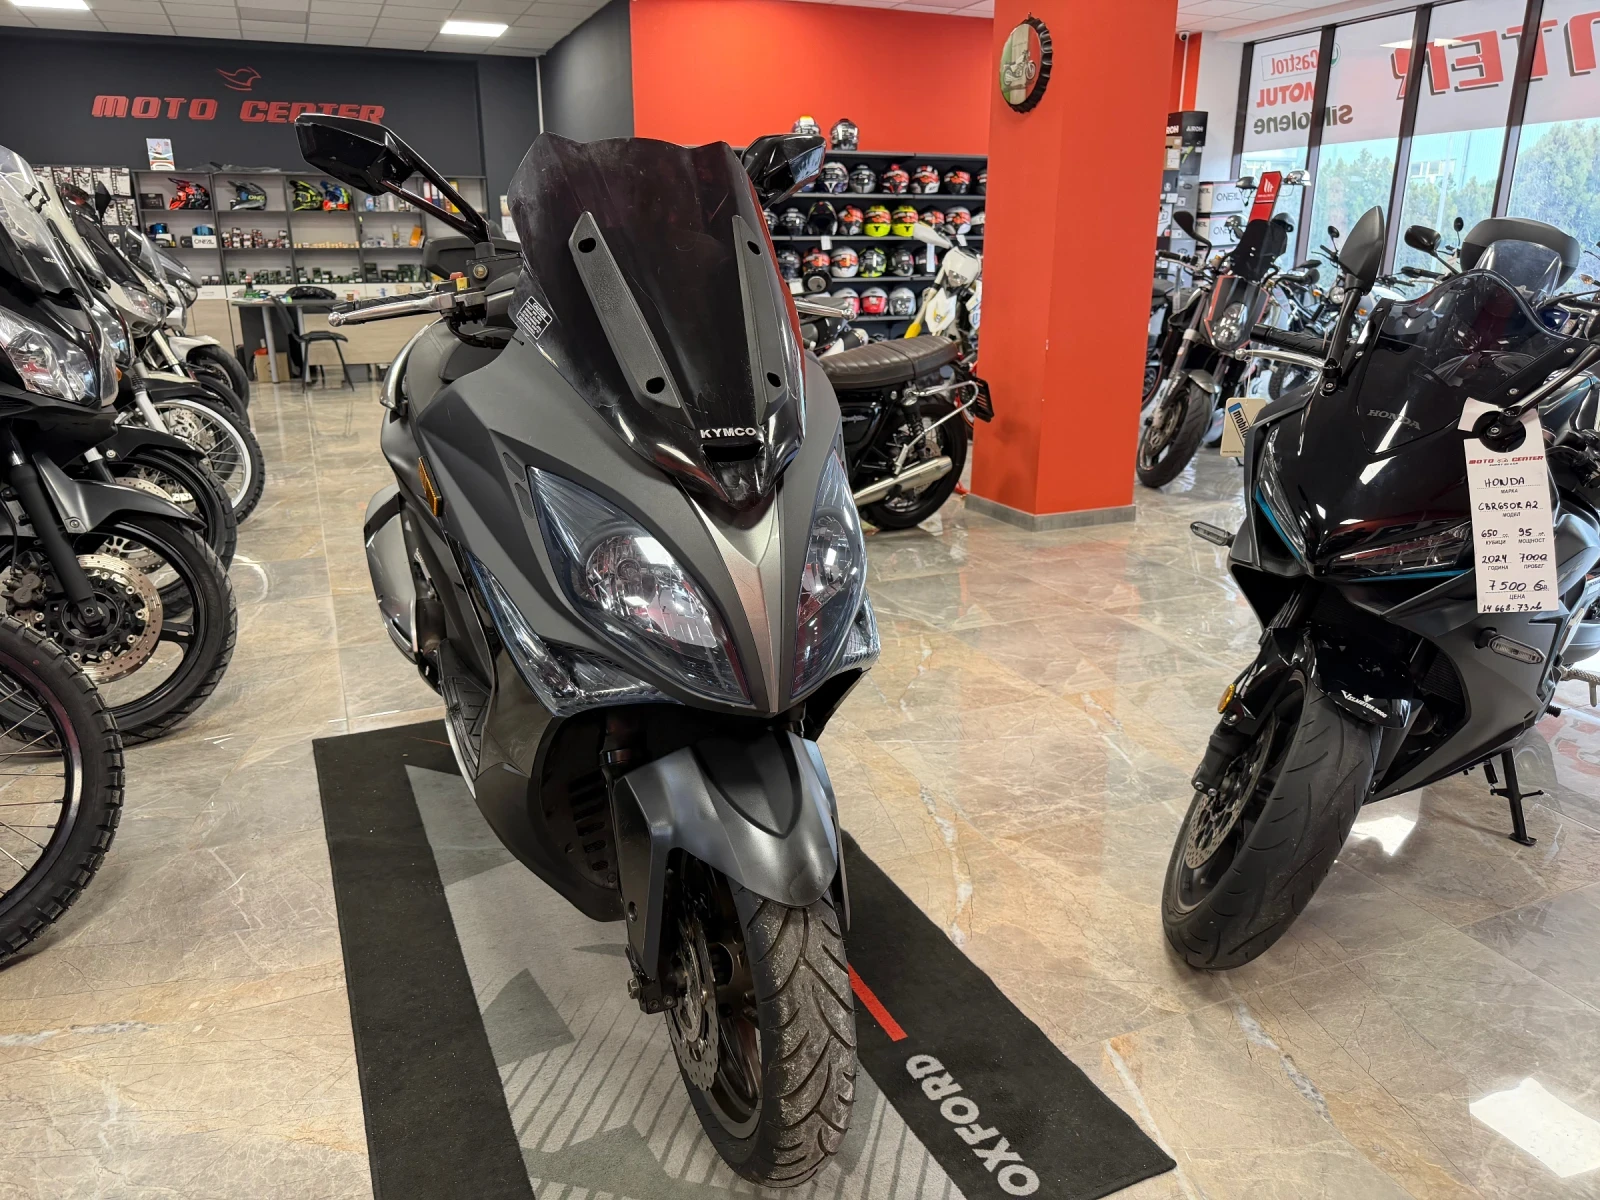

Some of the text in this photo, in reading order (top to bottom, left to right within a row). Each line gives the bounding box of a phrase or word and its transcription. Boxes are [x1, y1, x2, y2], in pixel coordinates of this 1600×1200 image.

[91, 95, 385, 124] MOTO CENTER
[532, 302, 547, 319] CAUTION
[1367, 409, 1421, 431] HONDA
[700, 427, 757, 439] KYMCO
[1484, 477, 1525, 488] HONDA
[1478, 500, 1539, 511] CBR650R A2
[1481, 528, 1498, 538] 650
[1518, 527, 1532, 537] 95
[1481, 554, 1508, 564] 2024
[905, 1053, 1040, 1196] OXFORD
